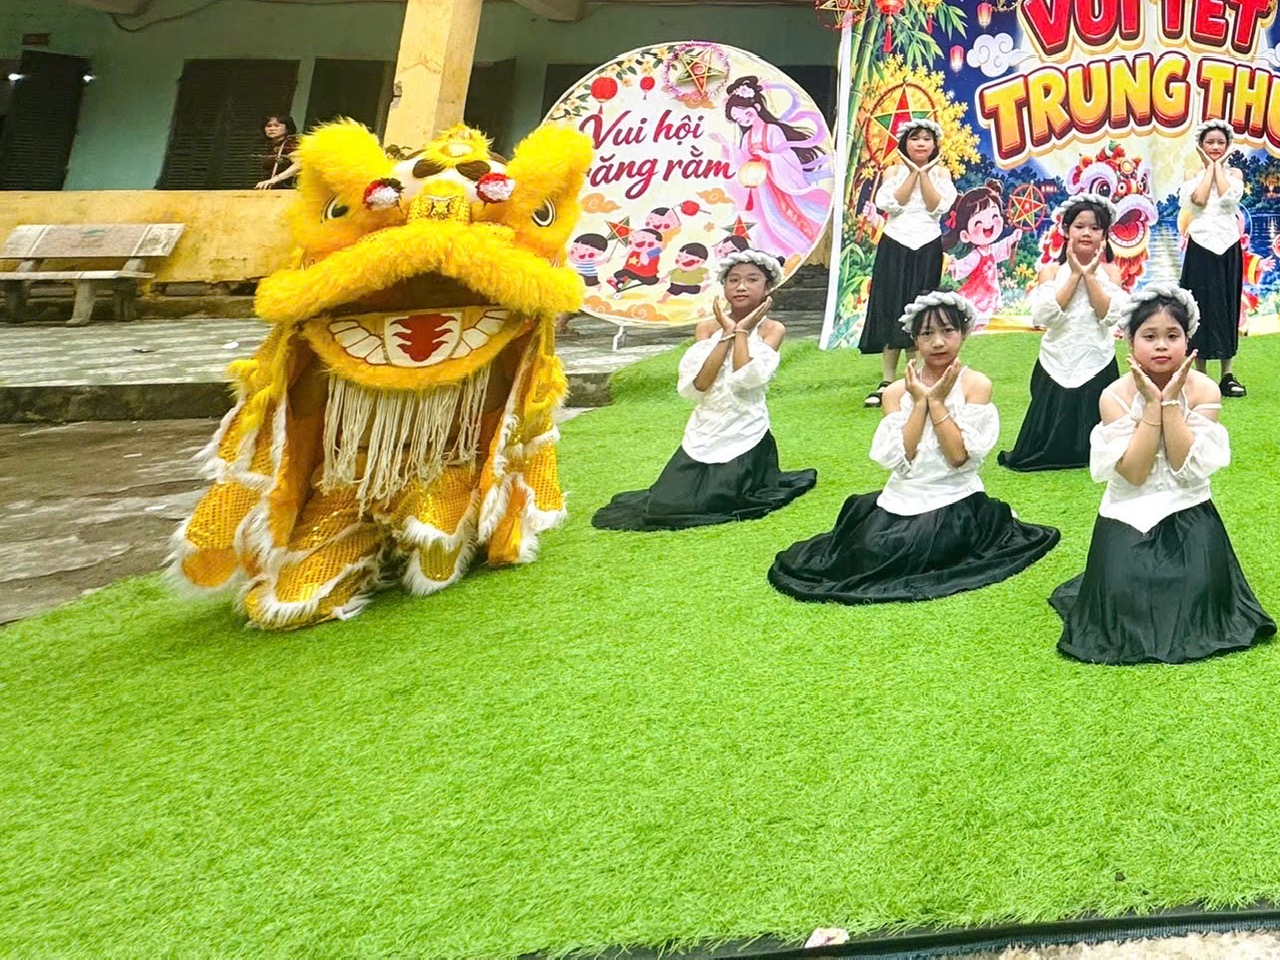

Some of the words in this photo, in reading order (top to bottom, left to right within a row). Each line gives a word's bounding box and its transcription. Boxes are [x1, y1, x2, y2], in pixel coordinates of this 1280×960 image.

[579, 109, 648, 150] Vui
[653, 109, 705, 145] hội
[979, 51, 1191, 160] TRUNG
[586, 153, 660, 200] ăng
[662, 145, 737, 182] rằm
